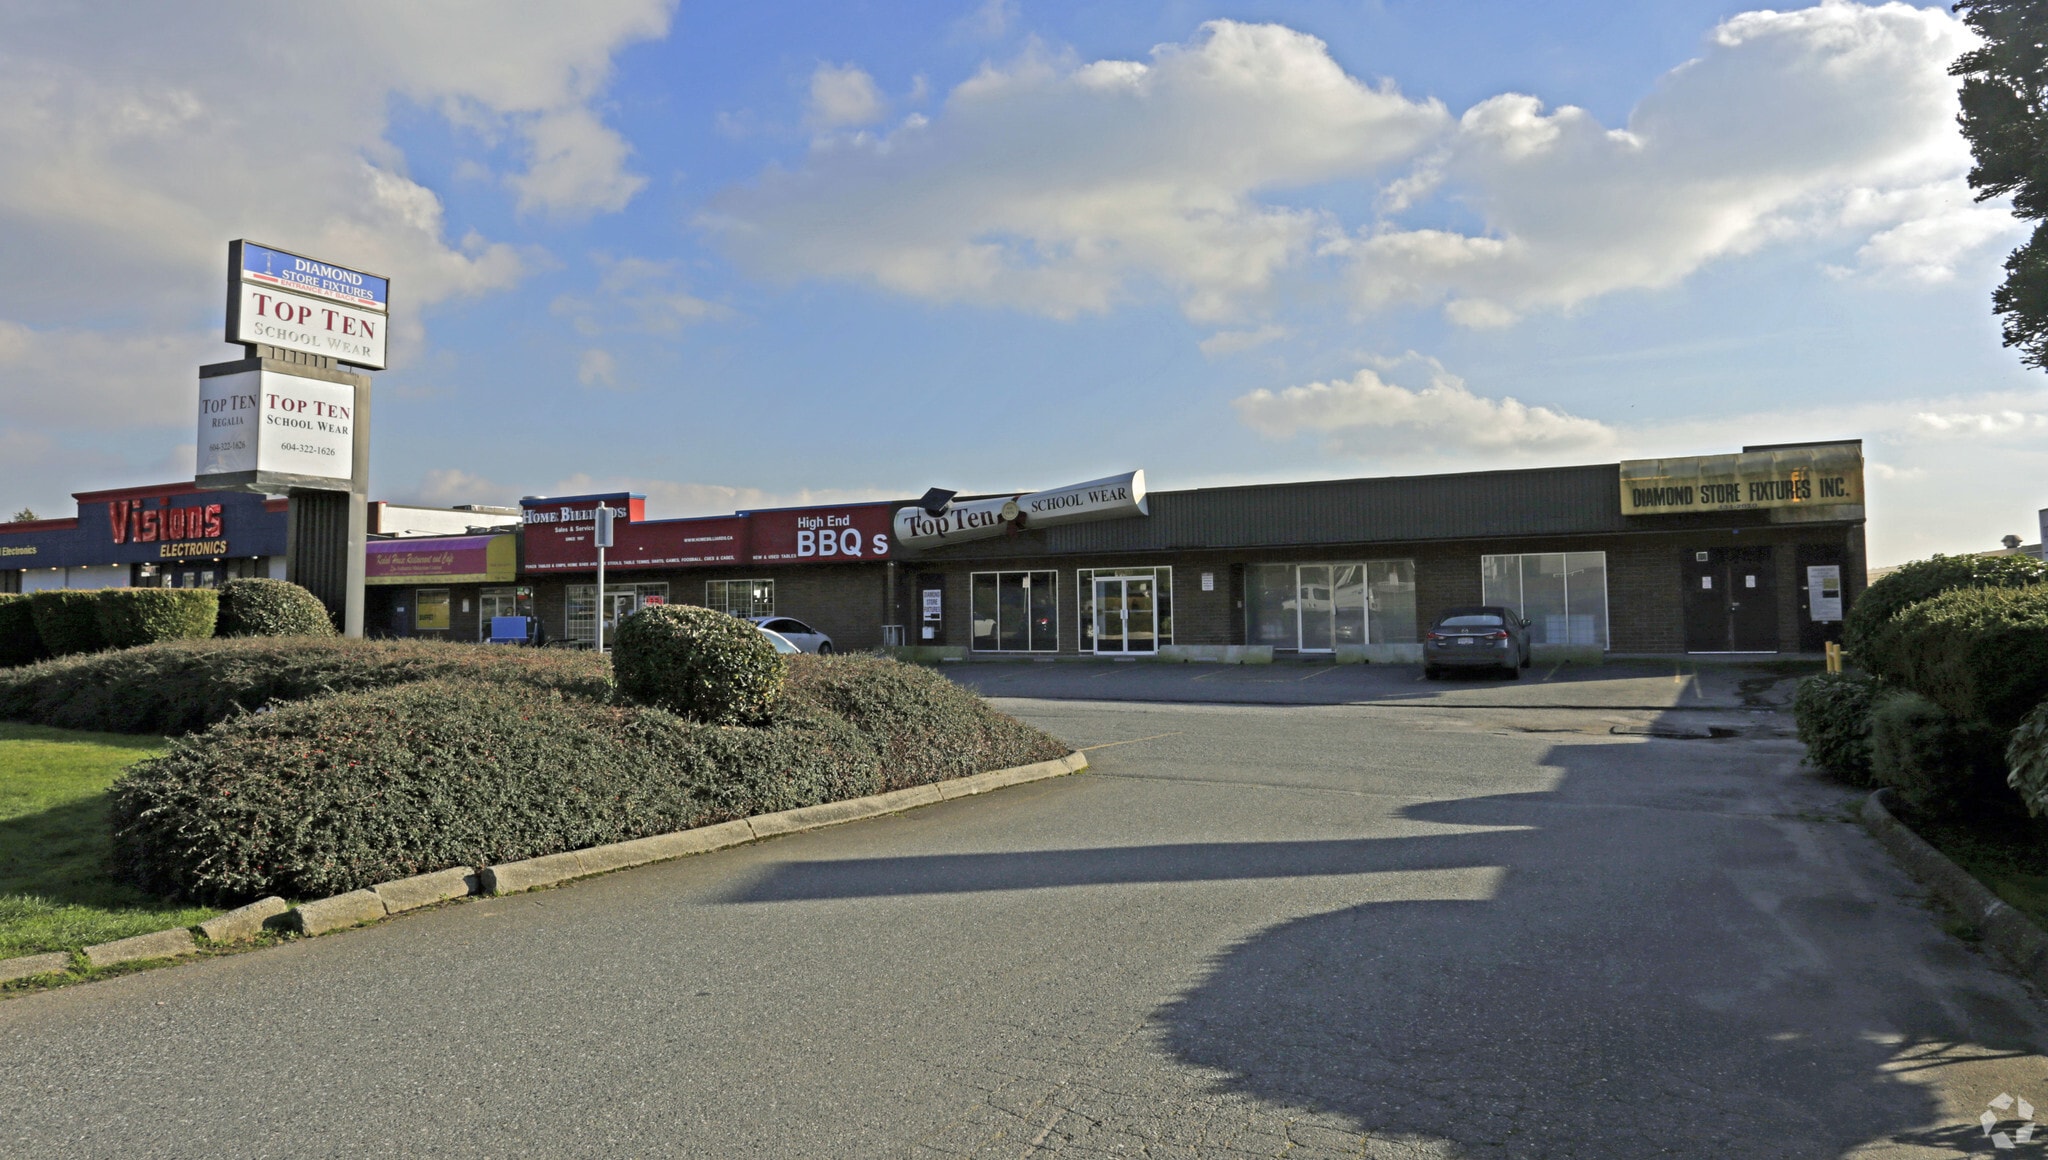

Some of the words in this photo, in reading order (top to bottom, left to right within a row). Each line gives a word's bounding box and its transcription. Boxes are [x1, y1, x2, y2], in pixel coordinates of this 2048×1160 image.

[282, 269, 320, 287] STORE
[322, 279, 374, 300] FIXTURES
[295, 259, 363, 286] DIAMOND
[280, 278, 322, 295] ENTRANCE
[323, 288, 334, 296] AT
[335, 290, 356, 302] BACK
[252, 292, 312, 325] TOP
[321, 308, 376, 340] TEN
[254, 321, 321, 347] SCHOOL
[327, 337, 371, 358] WEAR
[202, 398, 227, 414] TOP
[230, 394, 256, 410] TEN
[266, 393, 308, 413] TOP
[313, 400, 351, 420] TEN
[211, 416, 244, 428] REGALIA
[266, 414, 313, 430] SCHOOL
[317, 421, 349, 435] WEAR
[280, 442, 336, 456] 604-322-1626
[1031, 493, 1084, 513] SCHOOL
[1088, 487, 1128, 504] WEAR
[1632, 486, 1693, 508] DIAMOND
[1700, 482, 1741, 504] STORE
[1749, 479, 1812, 502] FIXTURES
[1819, 476, 1850, 498] INC.
[522, 510, 559, 525] HOME
[797, 516, 824, 531] High
[827, 514, 850, 527] End
[904, 513, 950, 539] Top
[951, 507, 995, 531] Ten
[2, 546, 38, 556] Electronics
[160, 540, 227, 558] ELECTRONICS
[797, 528, 862, 557] BBQ
